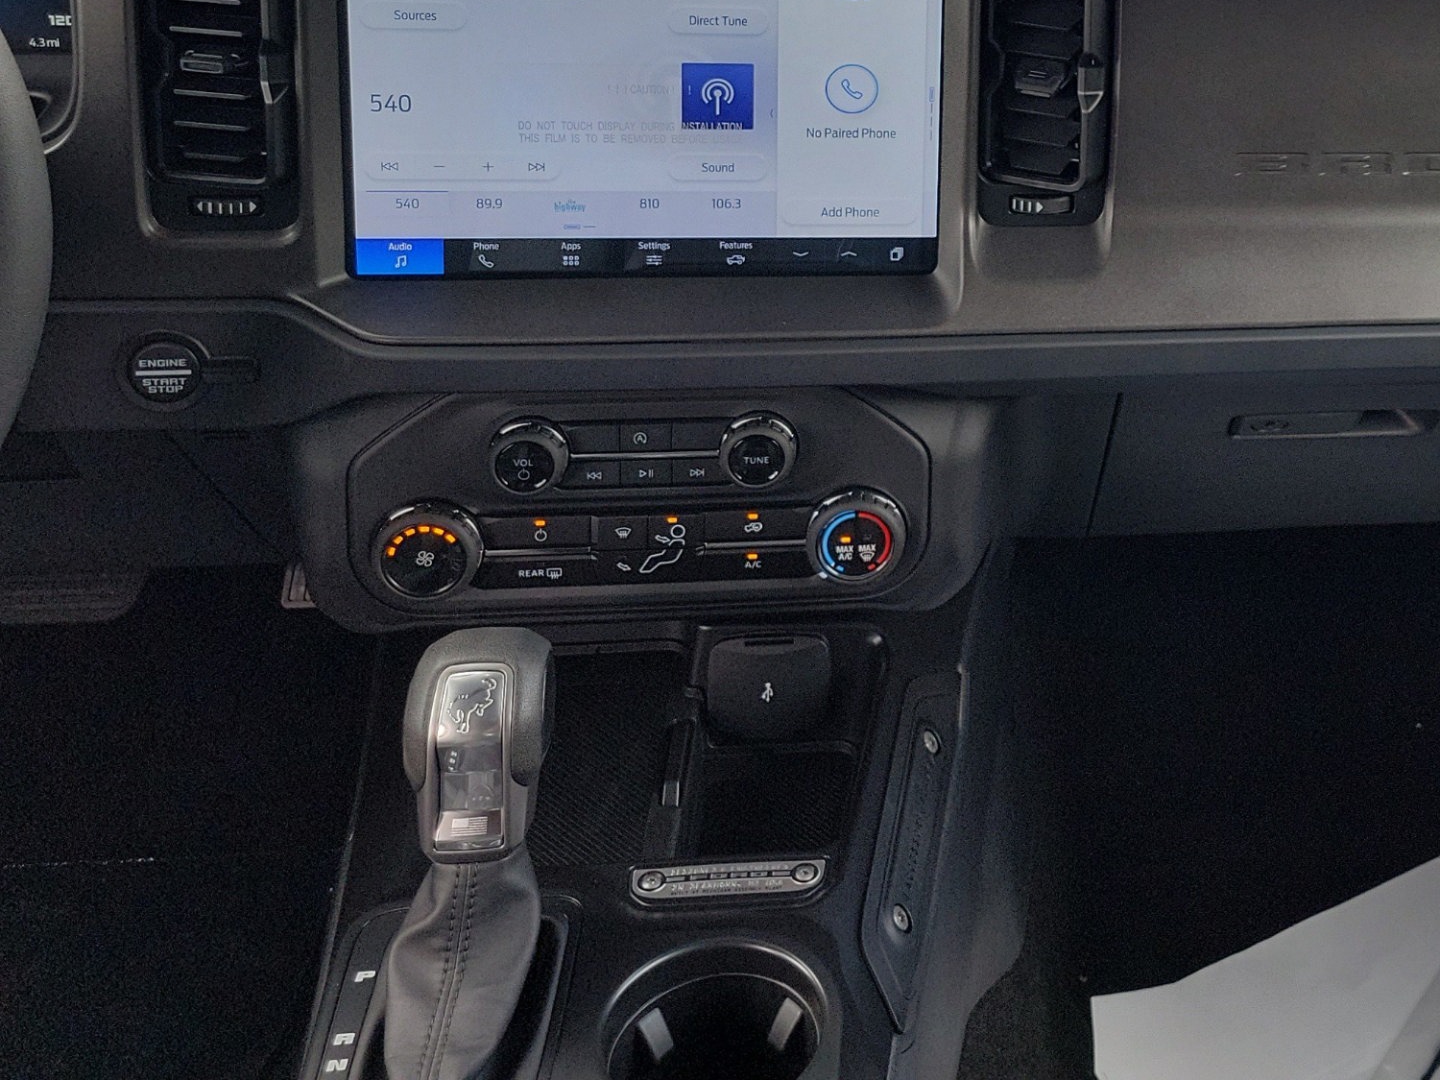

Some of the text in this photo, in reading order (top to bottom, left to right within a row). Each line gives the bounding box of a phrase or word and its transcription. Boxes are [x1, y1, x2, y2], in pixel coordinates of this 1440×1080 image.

[394, 9, 437, 21] Sources
[689, 15, 748, 27] Direct Tune
[29, 38, 60, 48] 4.3 mi
[370, 94, 412, 113] 540
[518, 121, 532, 131] DO
[537, 121, 556, 131] NOT
[562, 121, 593, 131] TOUCH
[599, 121, 634, 131] DISPLAY
[519, 133, 540, 143] THIS
[545, 133, 567, 143] FILM
[571, 133, 581, 143] IS
[585, 133, 597, 143] TO
[603, 133, 616, 143] BE
[621, 133, 666, 143] REMOVED
[806, 127, 897, 139] No Paired Phone
[701, 162, 735, 173] Sound
[395, 198, 420, 209] 540
[476, 198, 503, 209] 89.9
[639, 198, 660, 209] 810
[712, 198, 742, 209] 106.3
[820, 207, 880, 218] Add Phone
[388, 242, 412, 251] Audio
[473, 242, 500, 251] Phone
[561, 242, 581, 251] Apps
[638, 241, 671, 251] Settings
[719, 241, 753, 250] Features
[138, 358, 187, 368] ENGINE
[142, 377, 188, 386] START
[148, 385, 184, 394] STOP
[513, 458, 534, 467] VOL
[743, 456, 770, 464] TUNE
[836, 546, 854, 554] MAX
[858, 544, 876, 552] MAX
[745, 560, 762, 568] A/C
[518, 569, 545, 577] REAR
[354, 970, 376, 982] P
[326, 1058, 348, 1072] N
